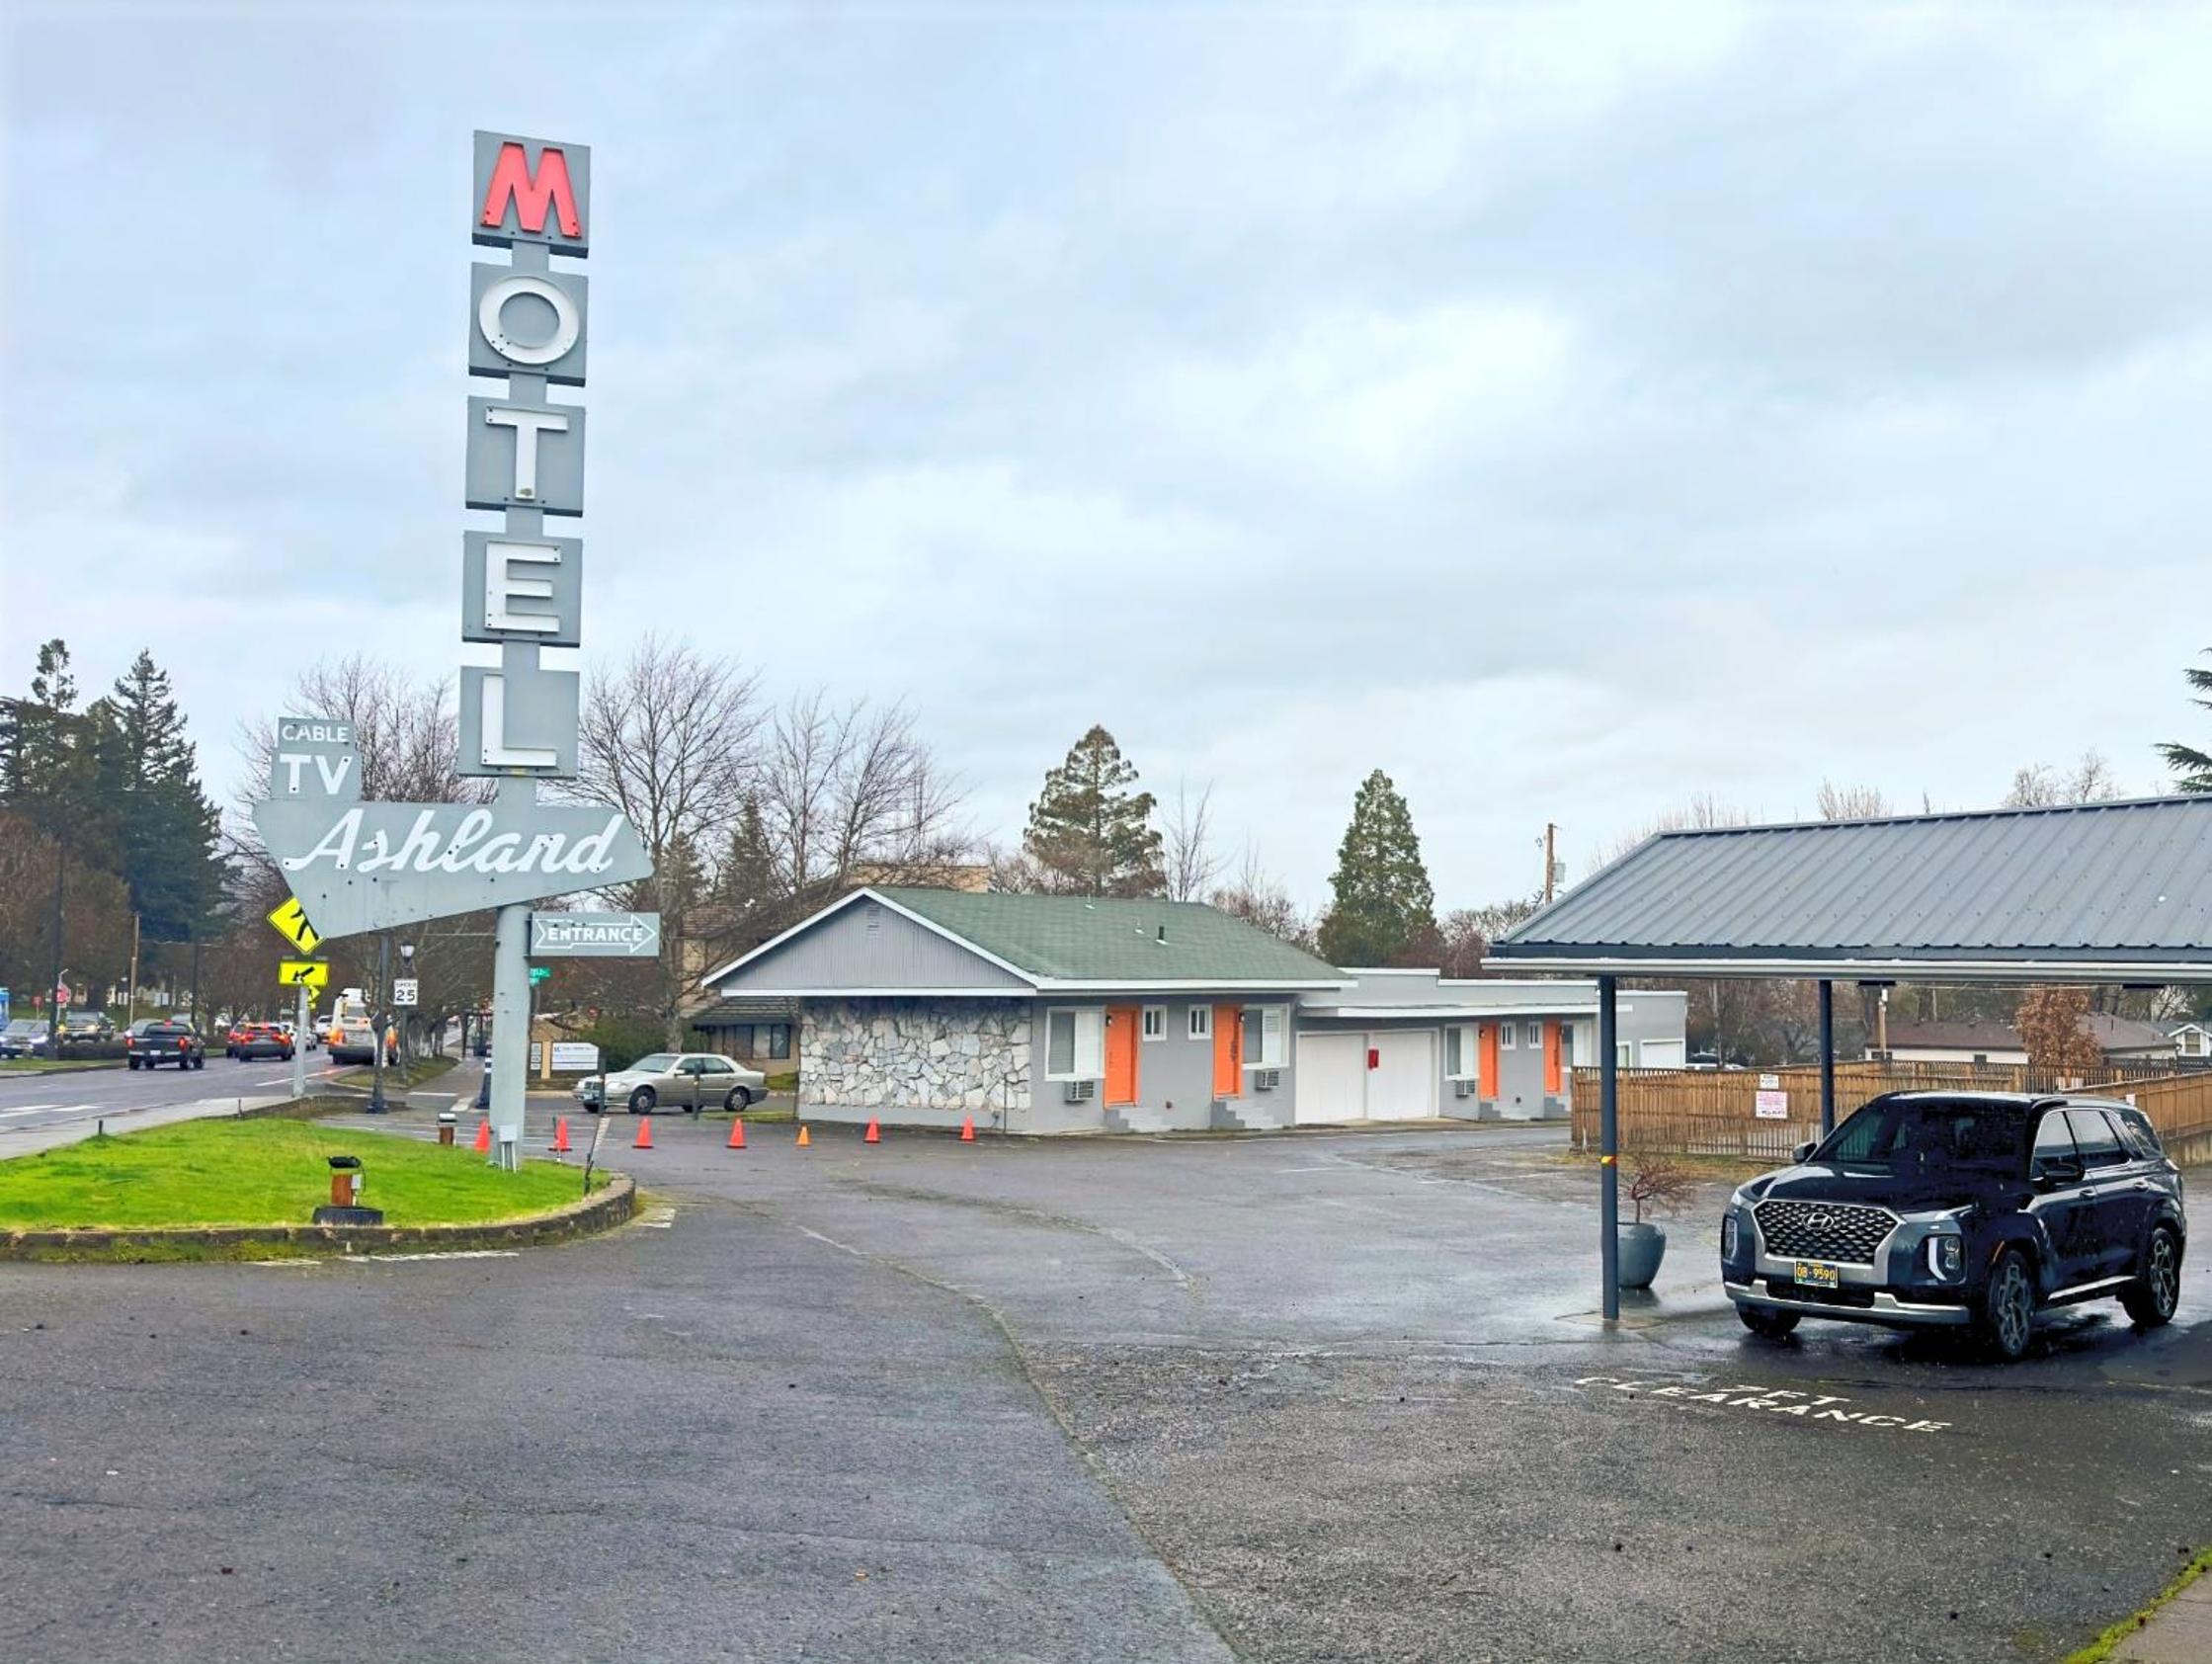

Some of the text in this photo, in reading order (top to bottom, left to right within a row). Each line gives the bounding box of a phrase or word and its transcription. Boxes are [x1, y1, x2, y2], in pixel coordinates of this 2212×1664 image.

[479, 140, 581, 766] MOTEL
[282, 724, 349, 742] CABLE
[279, 753, 354, 794] TV
[283, 808, 626, 874] Ashland
[547, 927, 644, 942] ENTRANCE
[395, 989, 416, 1002] 25
[1575, 1376, 1952, 1432] CLEARANCE
